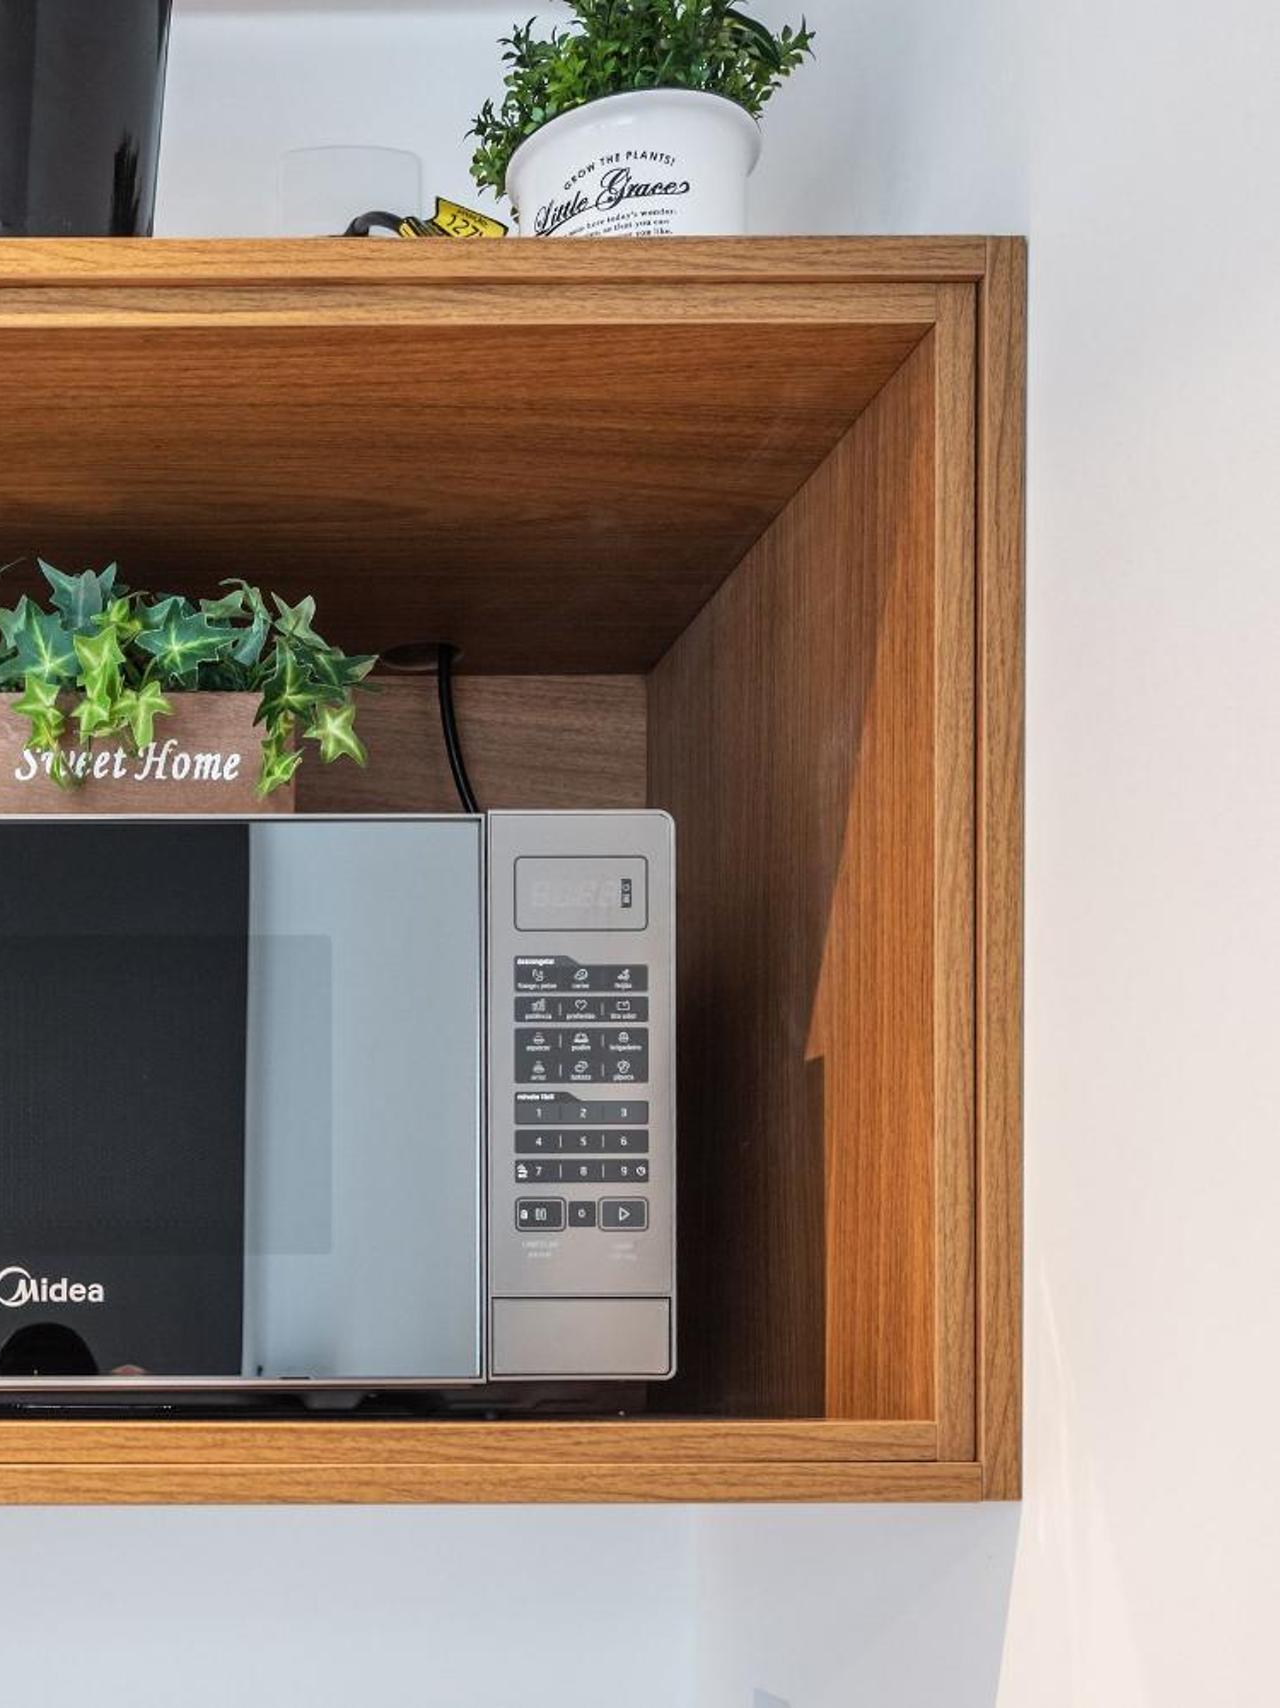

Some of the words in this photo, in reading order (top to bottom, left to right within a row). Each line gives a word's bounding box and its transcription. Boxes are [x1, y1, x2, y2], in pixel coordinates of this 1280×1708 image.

[563, 162, 596, 191] GROW
[599, 152, 621, 166] THE
[625, 150, 676, 166] PLANTS!
[134, 738, 241, 781] Home
[535, 1107, 543, 1119] 1
[579, 1107, 588, 1119] 2
[620, 1107, 628, 1119] 3
[535, 1136, 543, 1147] 4
[579, 1135, 588, 1147] 5
[620, 1135, 628, 1147] 6
[535, 1165, 543, 1177] 7
[579, 1165, 588, 1177] 8
[620, 1165, 628, 1177] 9
[577, 1208, 586, 1218] 0
